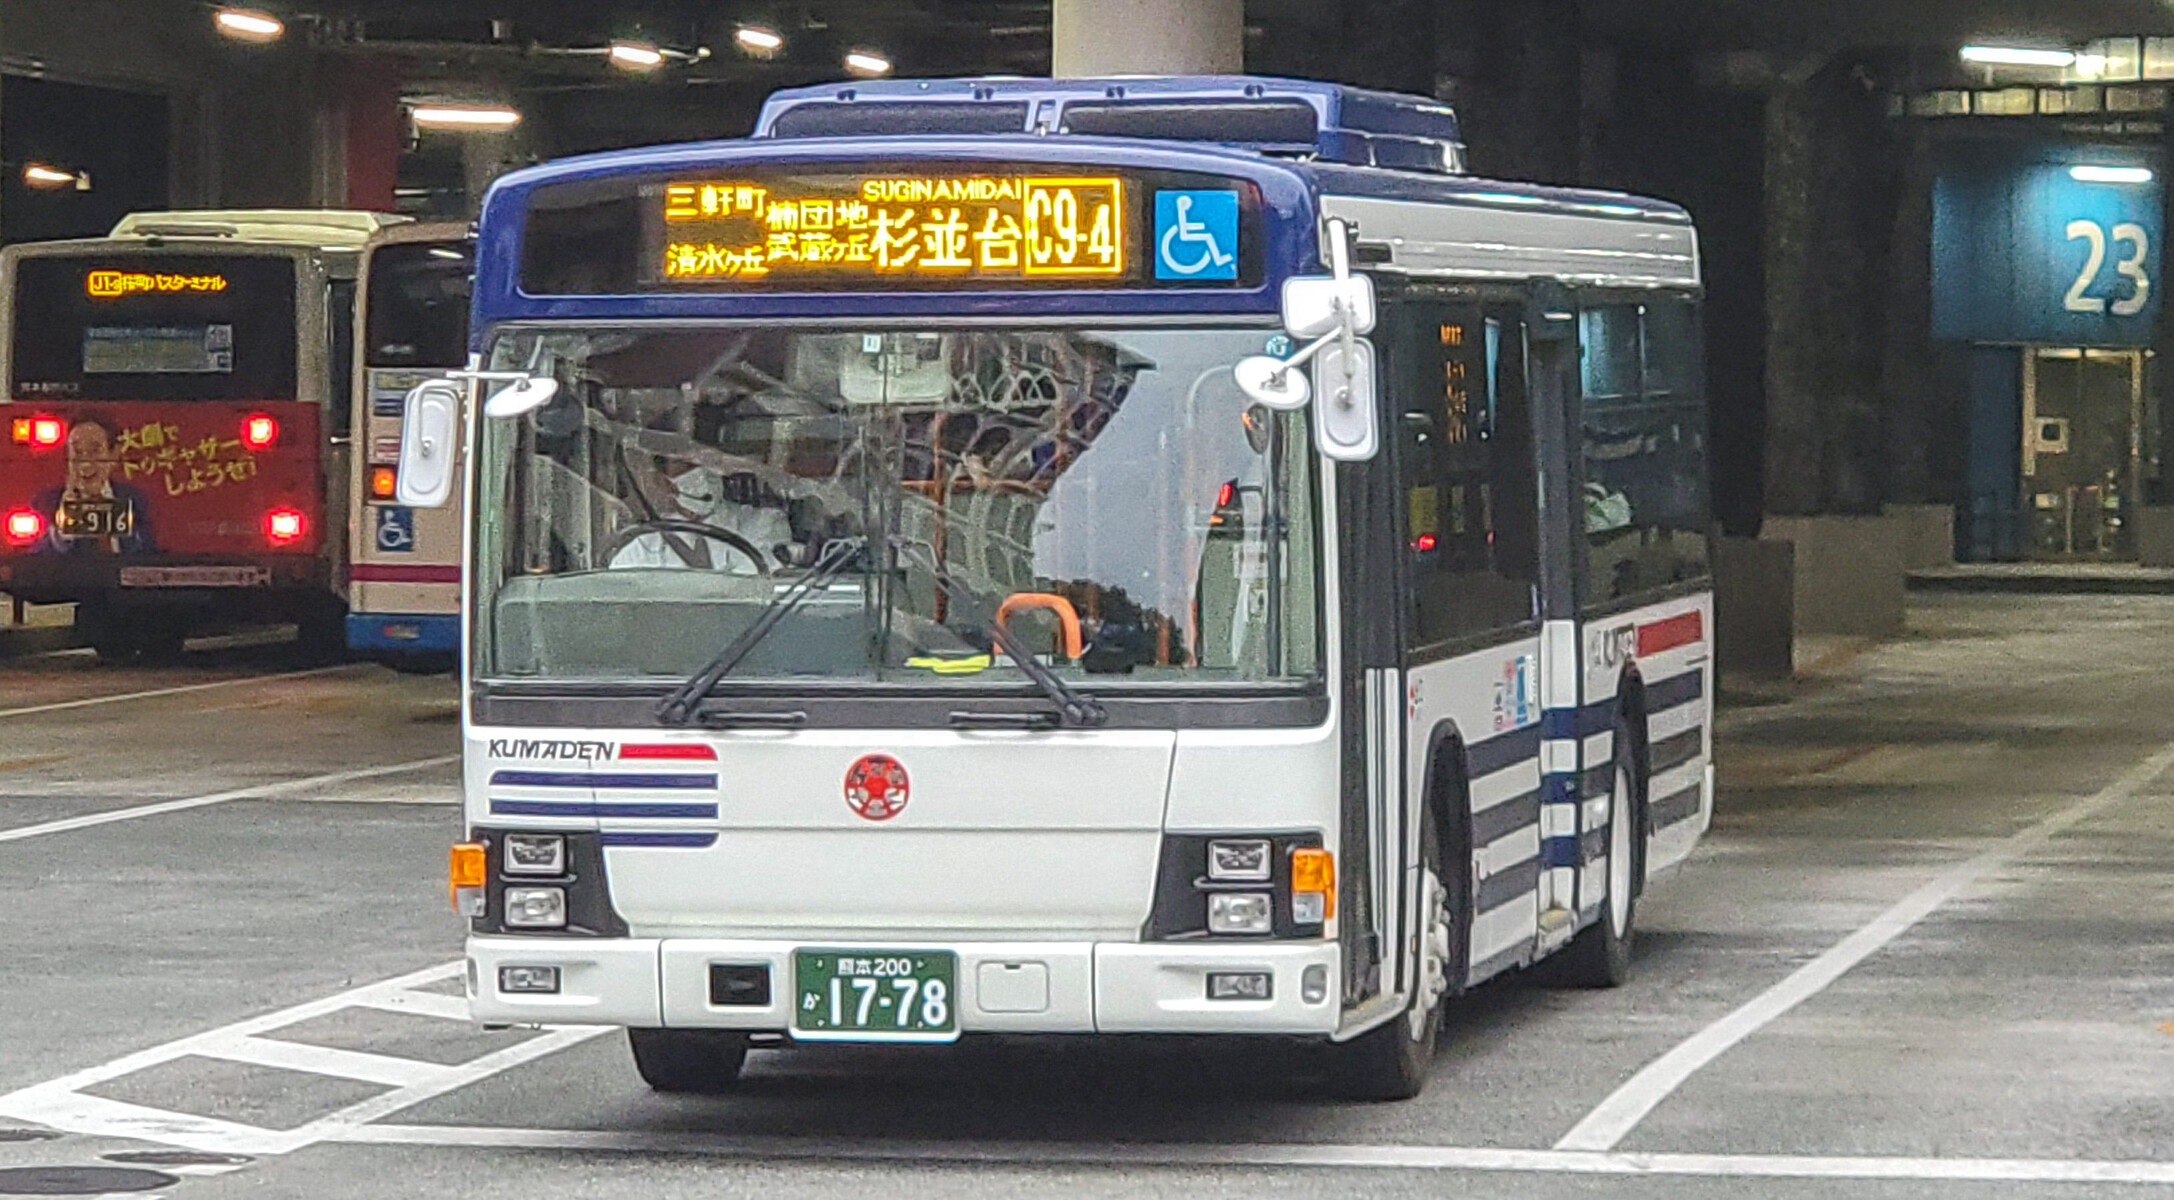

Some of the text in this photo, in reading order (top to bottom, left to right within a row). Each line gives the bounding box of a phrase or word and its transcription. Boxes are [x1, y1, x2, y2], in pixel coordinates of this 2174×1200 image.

[666, 185, 768, 217] 三軒町
[864, 179, 1021, 201] SUGINAMIDAI
[766, 200, 869, 231] 楠団地
[1031, 188, 1114, 264] C9-4
[868, 207, 1023, 267] 杉並台
[2064, 219, 2150, 316] 23
[488, 739, 615, 760] KUMADEN
[873, 958, 912, 976] 200
[829, 977, 948, 1027] 17-78
